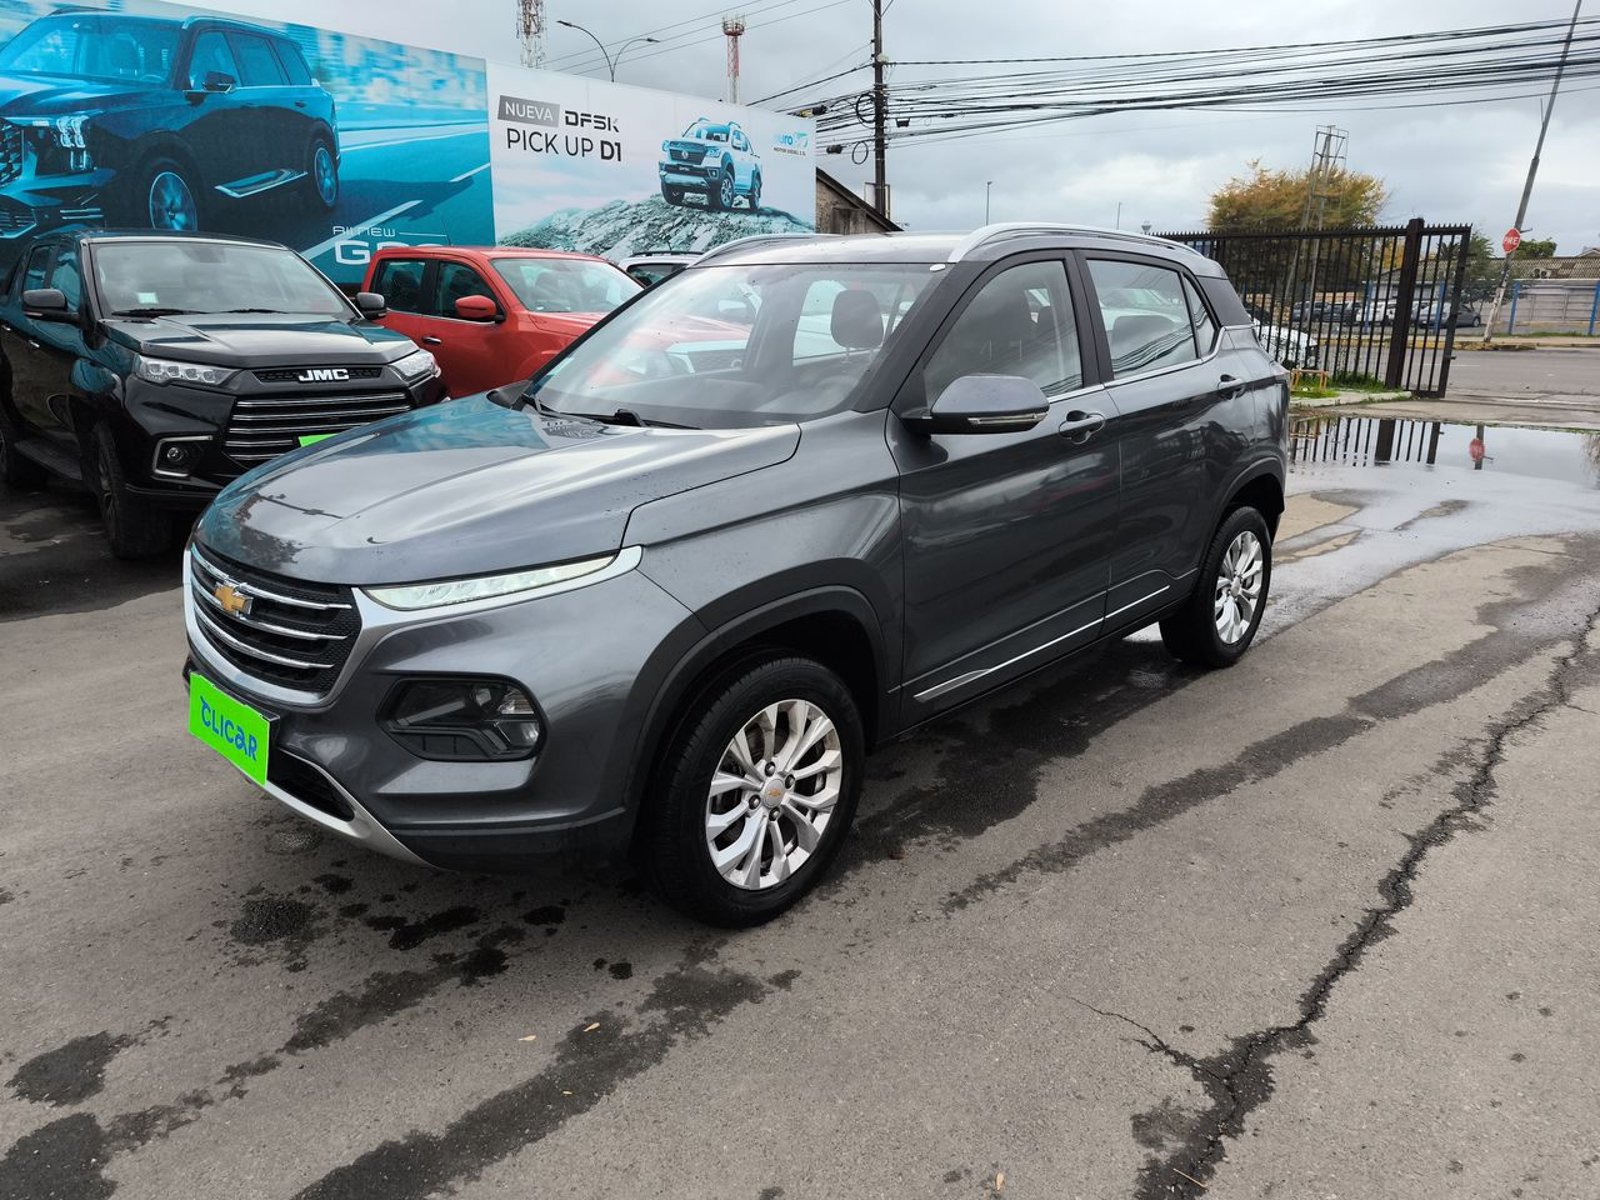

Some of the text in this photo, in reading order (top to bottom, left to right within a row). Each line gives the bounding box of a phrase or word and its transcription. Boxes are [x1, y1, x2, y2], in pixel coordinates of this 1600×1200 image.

[504, 101, 620, 133] NUEVA DFSK
[506, 128, 622, 162] PICK UP D1
[298, 368, 350, 382] JMC
